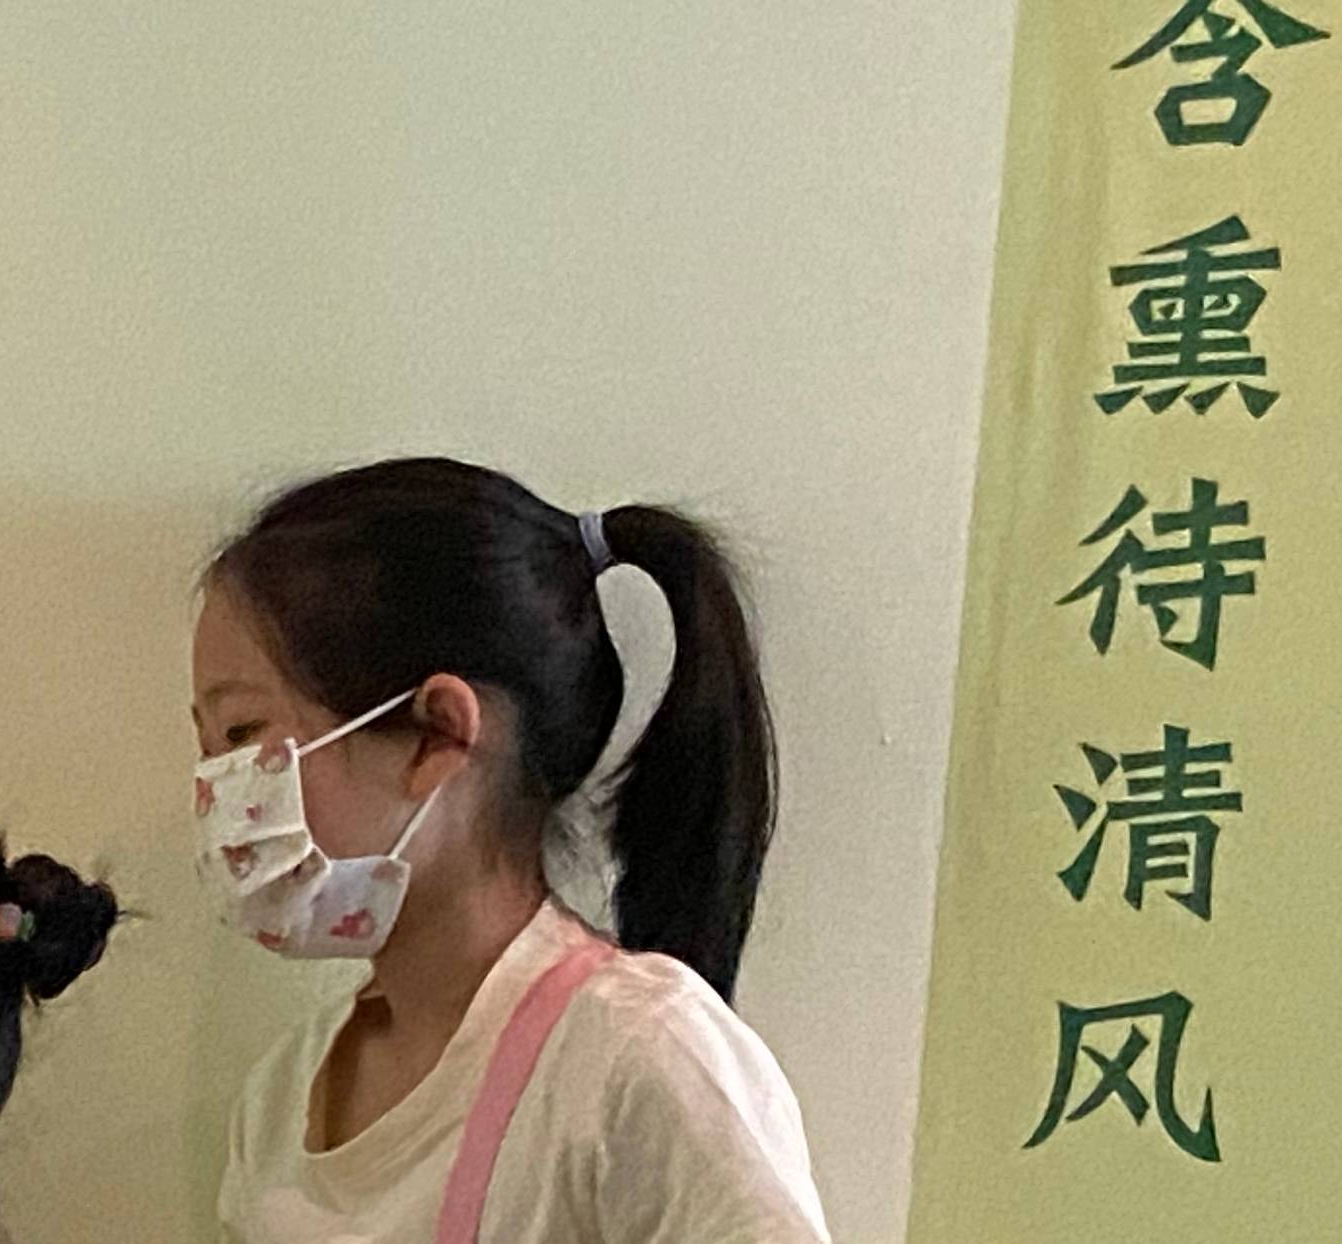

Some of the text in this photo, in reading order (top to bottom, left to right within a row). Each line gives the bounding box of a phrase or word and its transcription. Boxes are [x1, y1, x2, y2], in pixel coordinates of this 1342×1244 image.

[1021, 0, 1331, 1163] 含熏待清风
